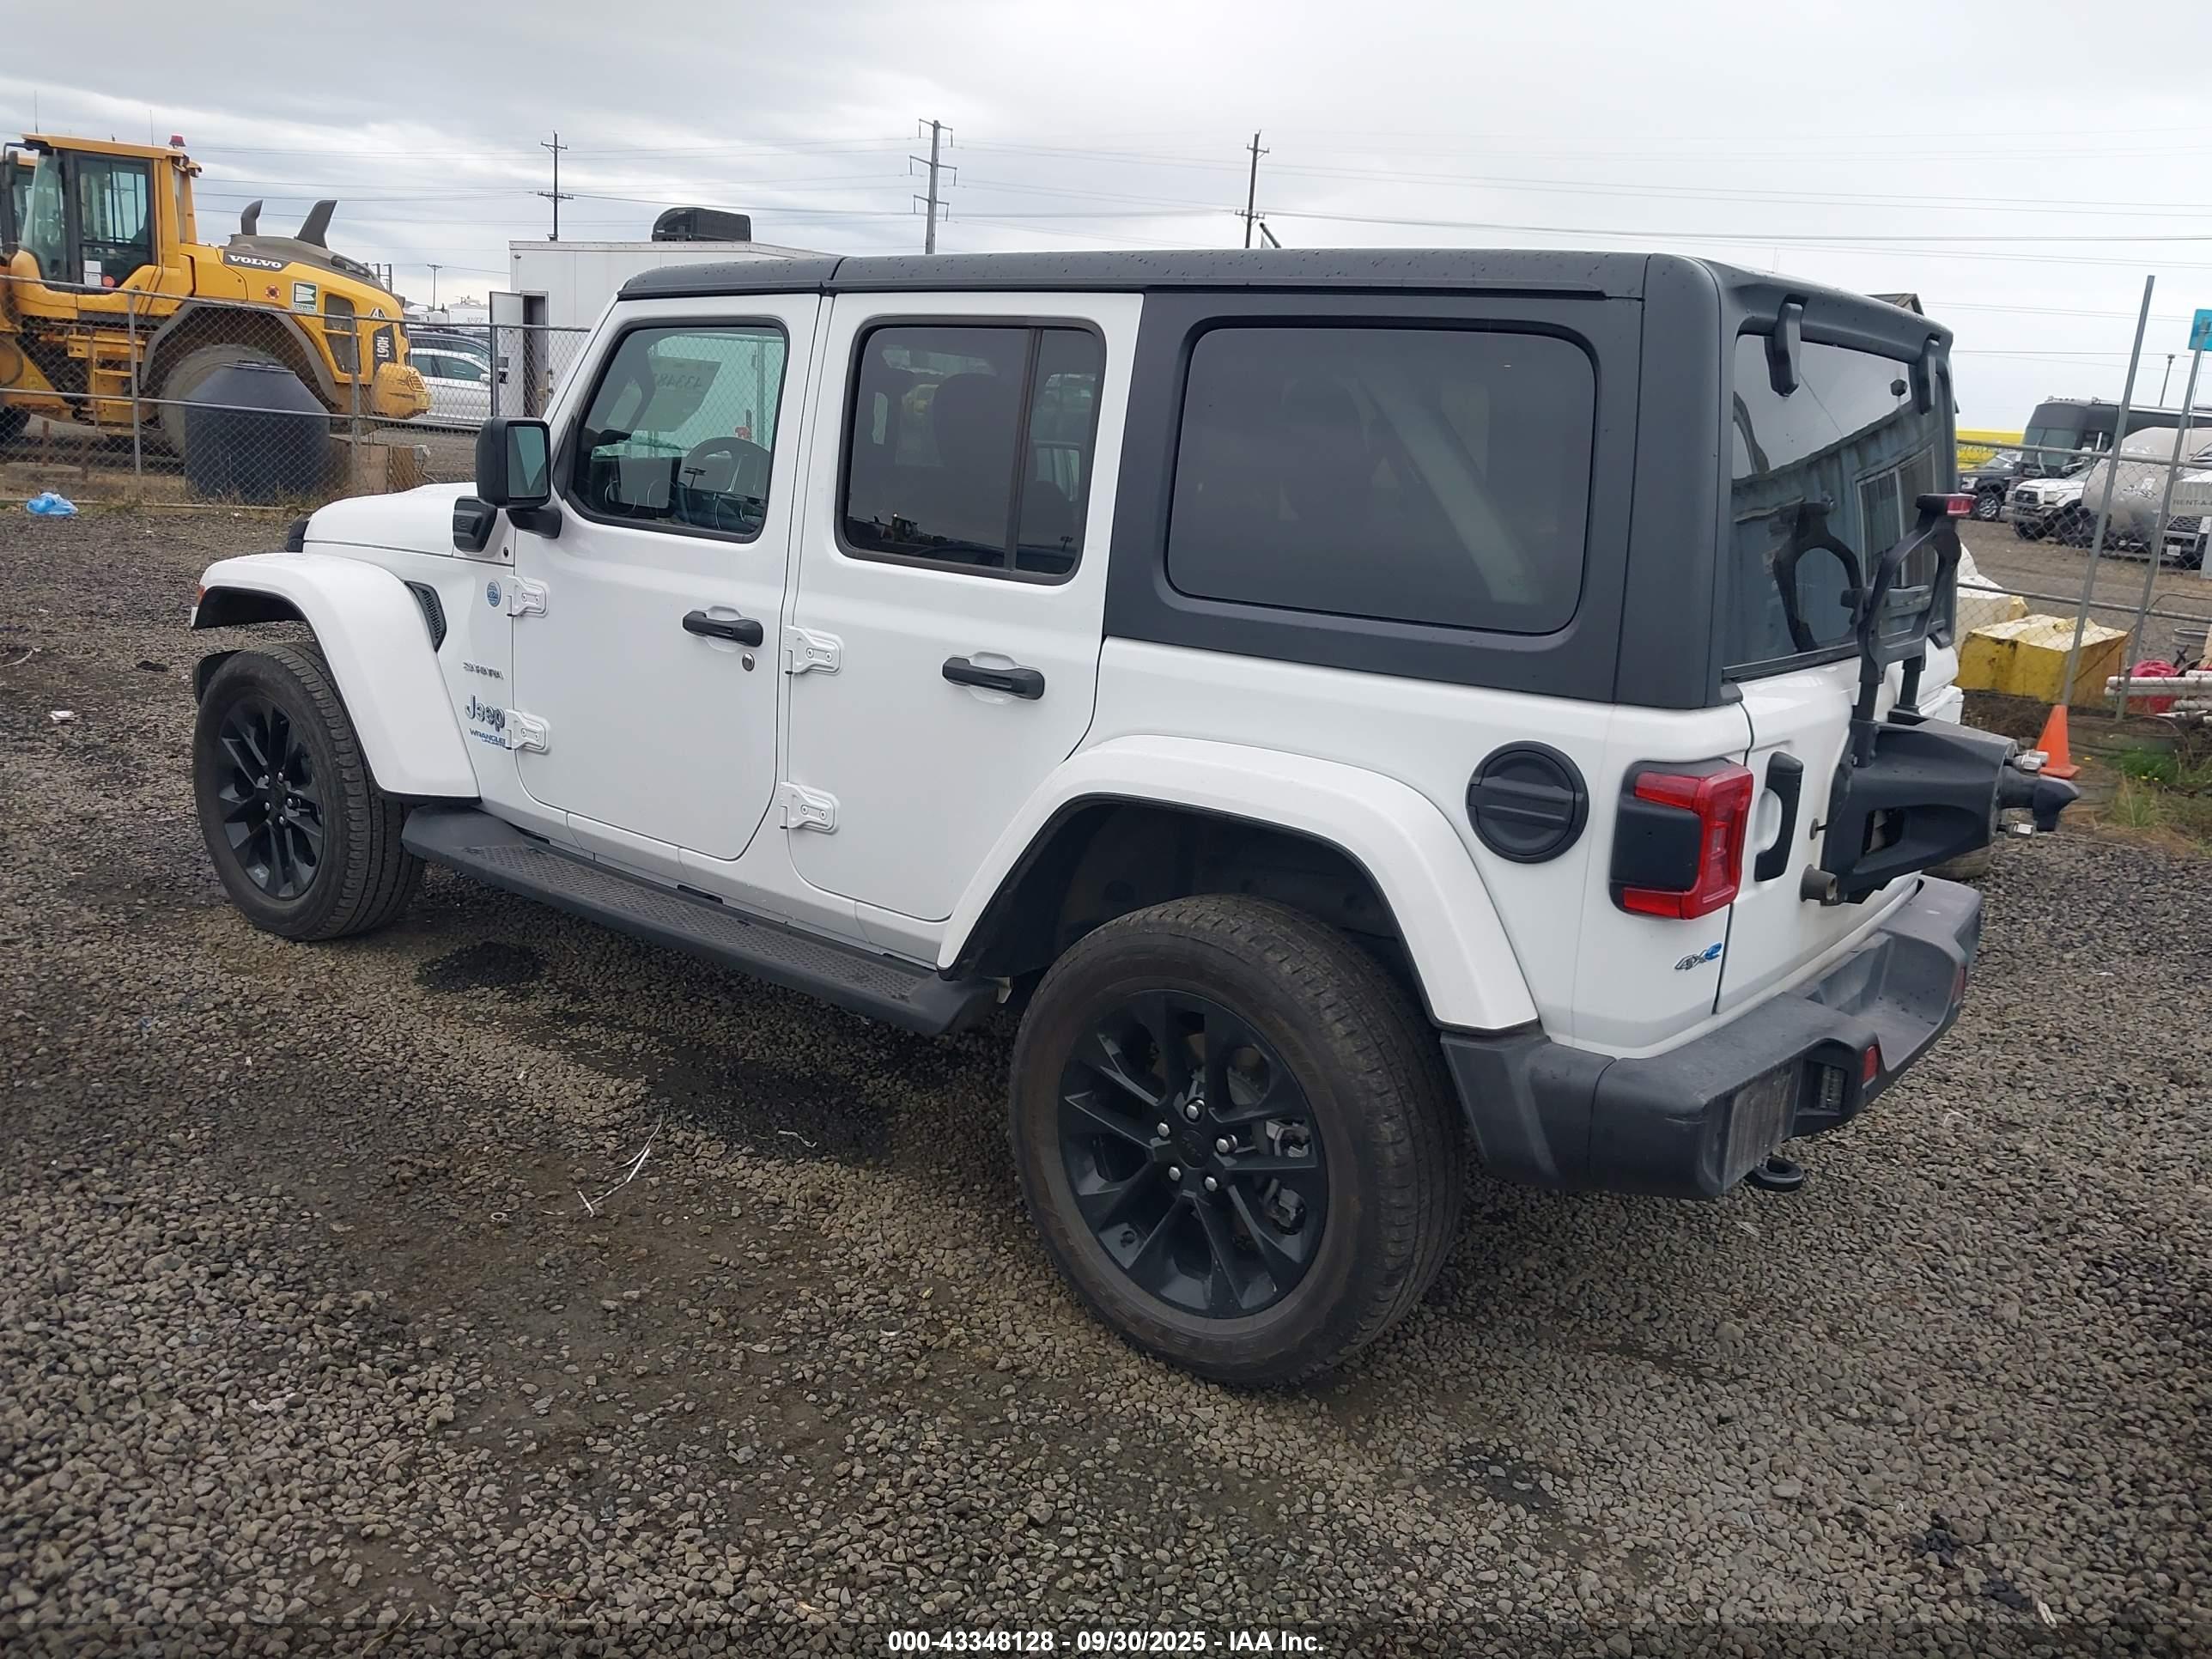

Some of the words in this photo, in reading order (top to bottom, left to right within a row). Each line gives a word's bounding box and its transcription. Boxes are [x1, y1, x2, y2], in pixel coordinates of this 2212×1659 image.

[228, 253, 282, 269] VOLVO
[376, 336, 390, 358] L90H
[465, 694, 506, 732] Jeep
